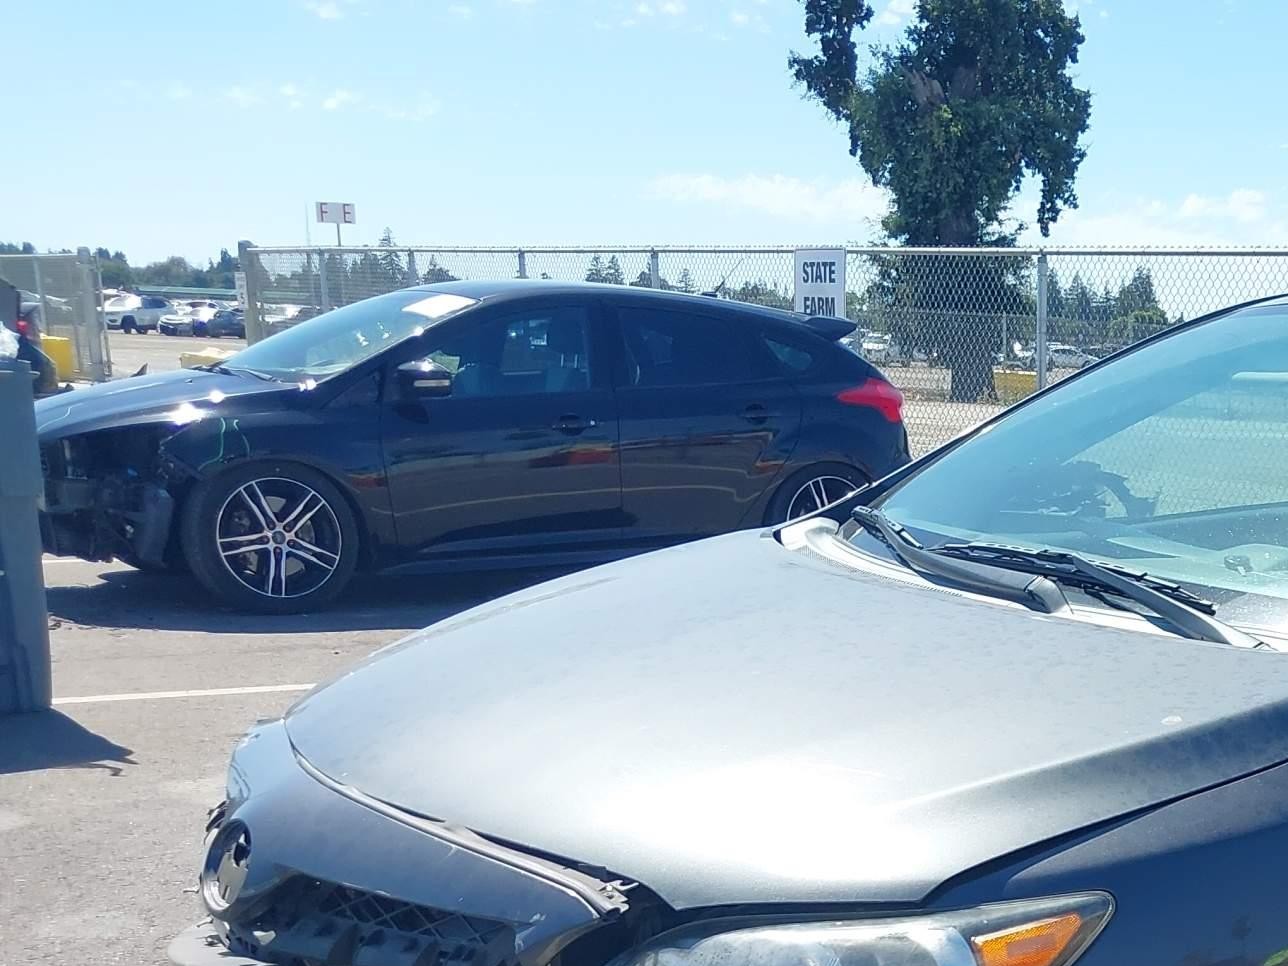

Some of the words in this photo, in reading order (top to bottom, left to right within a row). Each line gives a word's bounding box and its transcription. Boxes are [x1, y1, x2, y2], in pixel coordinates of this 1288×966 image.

[320, 202, 328, 222] F
[343, 203, 352, 223] E
[802, 261, 836, 283] STATE
[803, 296, 836, 317] FARM
